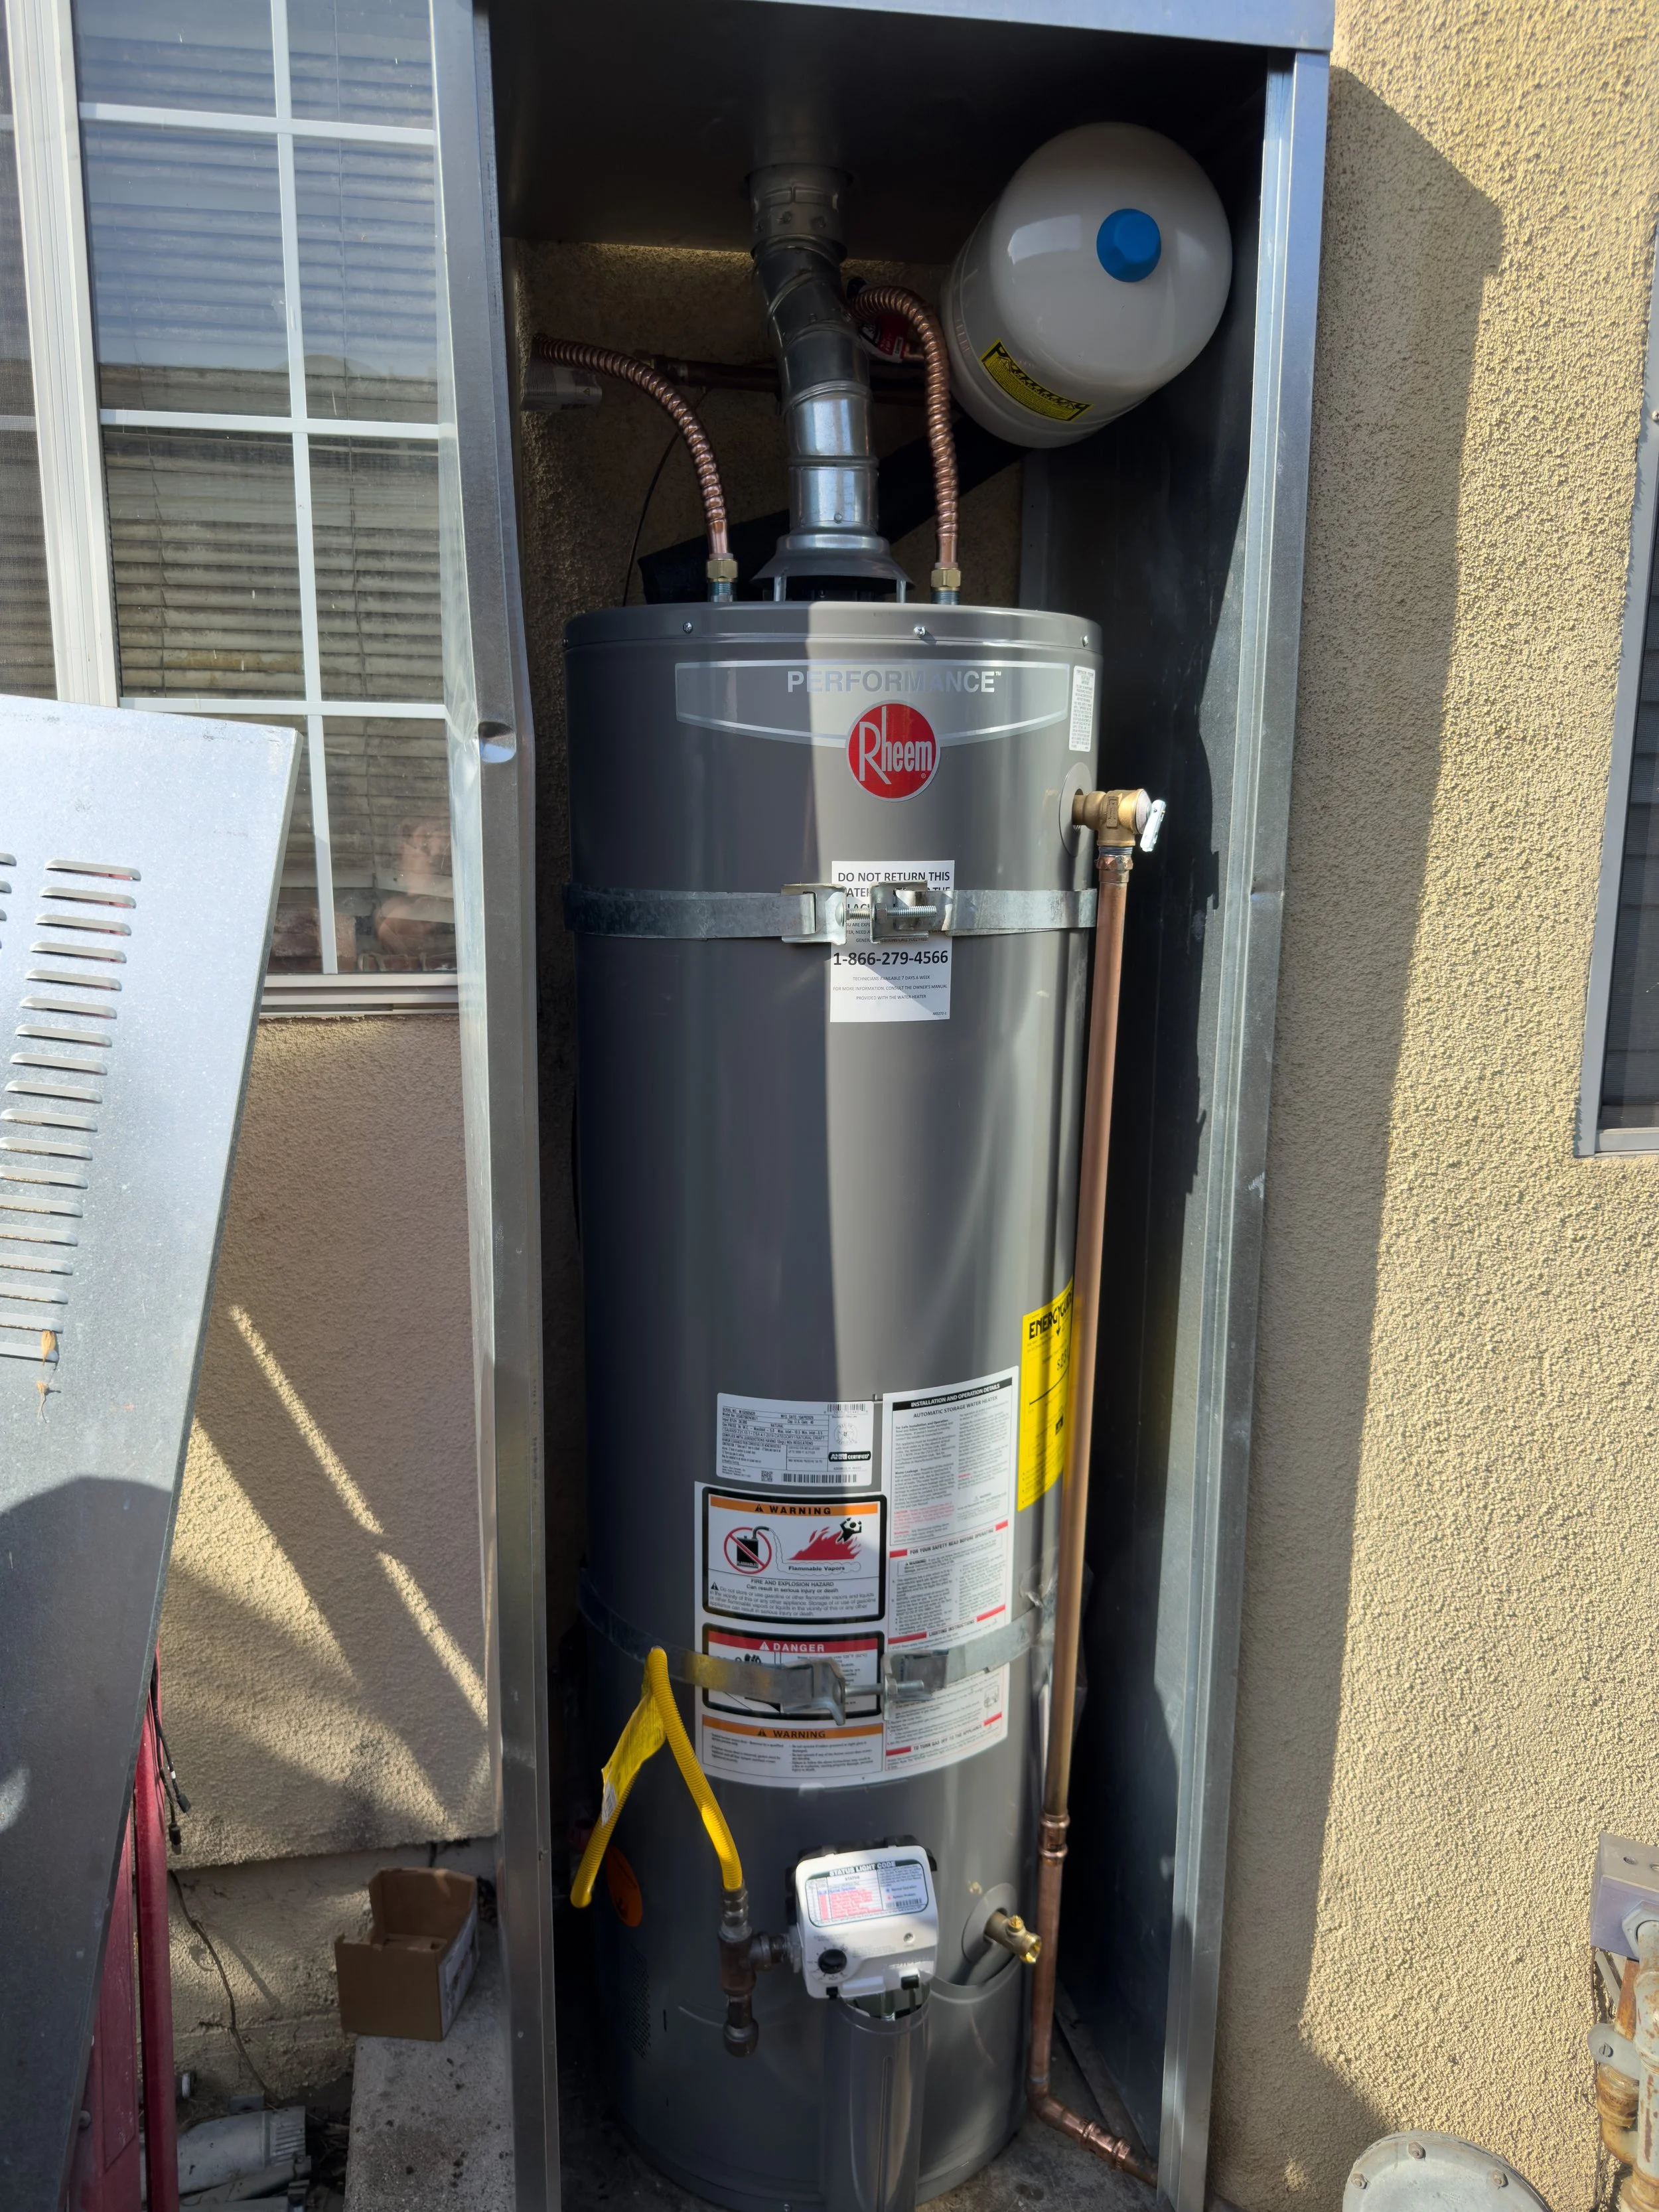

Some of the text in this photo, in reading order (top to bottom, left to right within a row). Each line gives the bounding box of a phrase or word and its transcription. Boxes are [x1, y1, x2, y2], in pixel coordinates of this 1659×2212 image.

[859, 705, 932, 784] Rheem
[838, 871, 950, 882] DO NOT RETURN THIS
[833, 950, 948, 966] 1-866-279-4566
[910, 1397, 946, 1408] INSTALLATION
[958, 1388, 983, 1399] OPERATION
[983, 1383, 1000, 1394] DETAILS
[913, 1409, 943, 1418] AUTOMATIC
[944, 1405, 966, 1414] STORAGE
[770, 1505, 831, 1514] WARNING
[773, 1643, 825, 1653] DANGER
[773, 1730, 826, 1738] WARNING
[830, 1868, 855, 1877] STATUS
[855, 1864, 876, 1873] LIGHT
